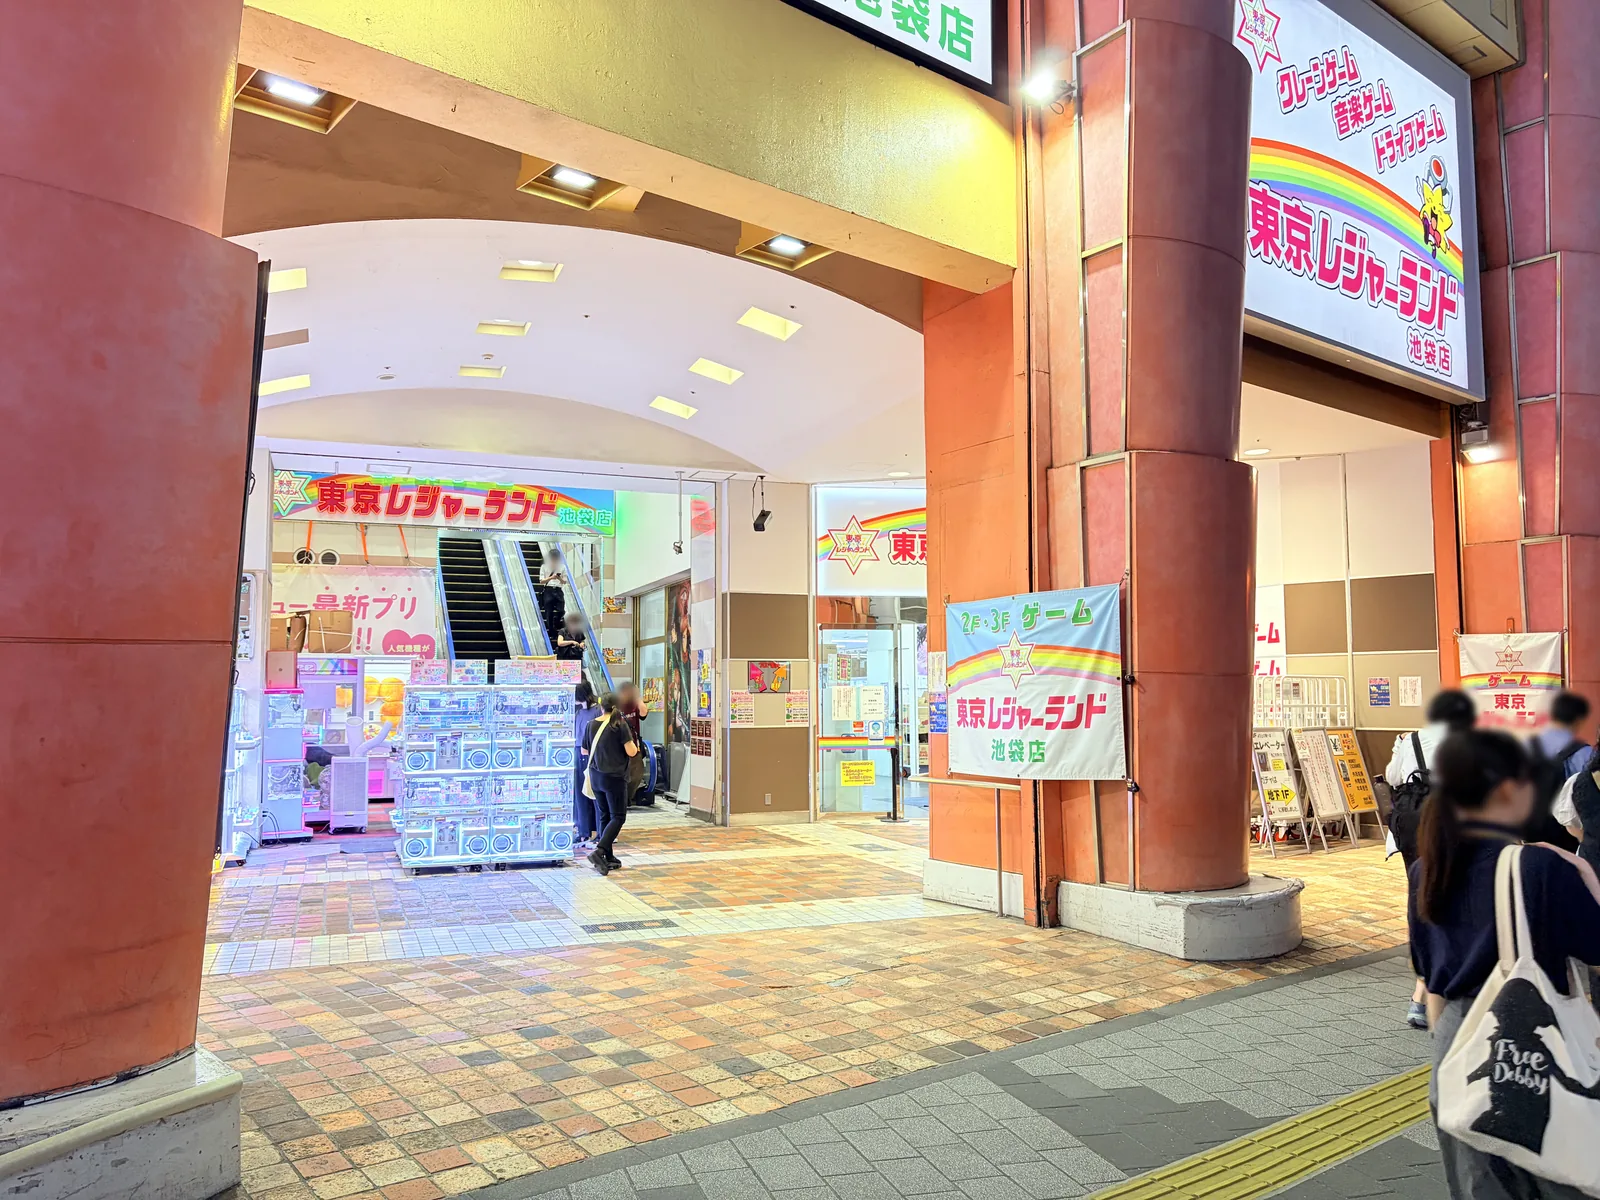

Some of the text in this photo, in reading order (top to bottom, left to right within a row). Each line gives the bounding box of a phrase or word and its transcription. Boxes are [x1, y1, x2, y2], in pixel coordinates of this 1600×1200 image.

[1278, 49, 1360, 110] クレーンゲーム
[1333, 83, 1395, 136] 音楽ゲーム
[1373, 108, 1446, 170] ドライブゲーム
[1249, 186, 1458, 332] 東京レジャーランド
[1408, 330, 1451, 372] 池袋店
[316, 480, 613, 526] 東京レジャーランド 池袋店
[1021, 598, 1094, 632] ゲーム
[1487, 673, 1532, 688] ゲーム
[956, 692, 1108, 731] 東京レジャーランド
[1493, 693, 1526, 710] 東京
[991, 737, 1048, 763] 池袋店
[1254, 740, 1286, 750] エレベーター
[1494, 1038, 1549, 1071] Free
[1494, 1062, 1549, 1095] Debby
